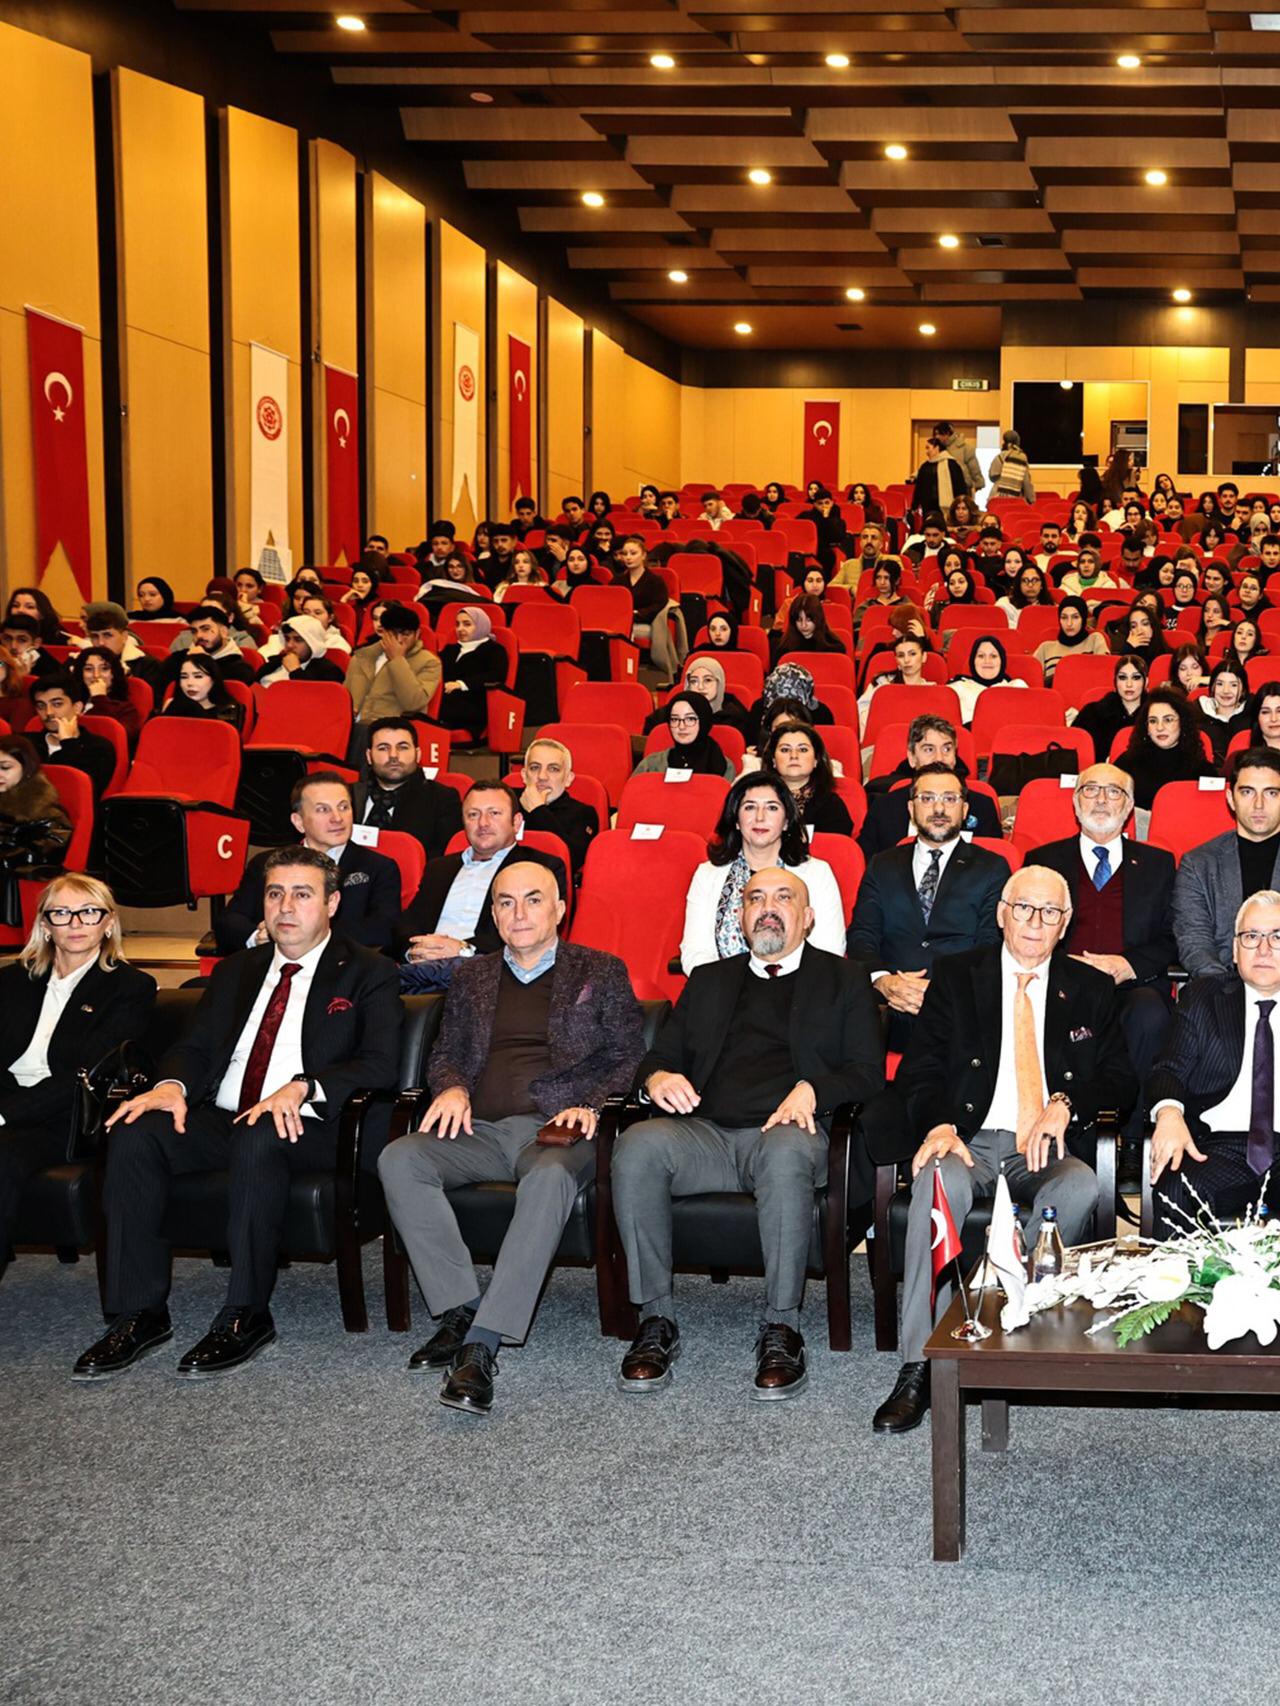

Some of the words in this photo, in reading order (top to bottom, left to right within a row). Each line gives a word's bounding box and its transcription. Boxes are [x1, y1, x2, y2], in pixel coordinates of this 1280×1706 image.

[508, 711, 516, 730] F
[430, 743, 439, 763] E
[217, 834, 233, 859] C
